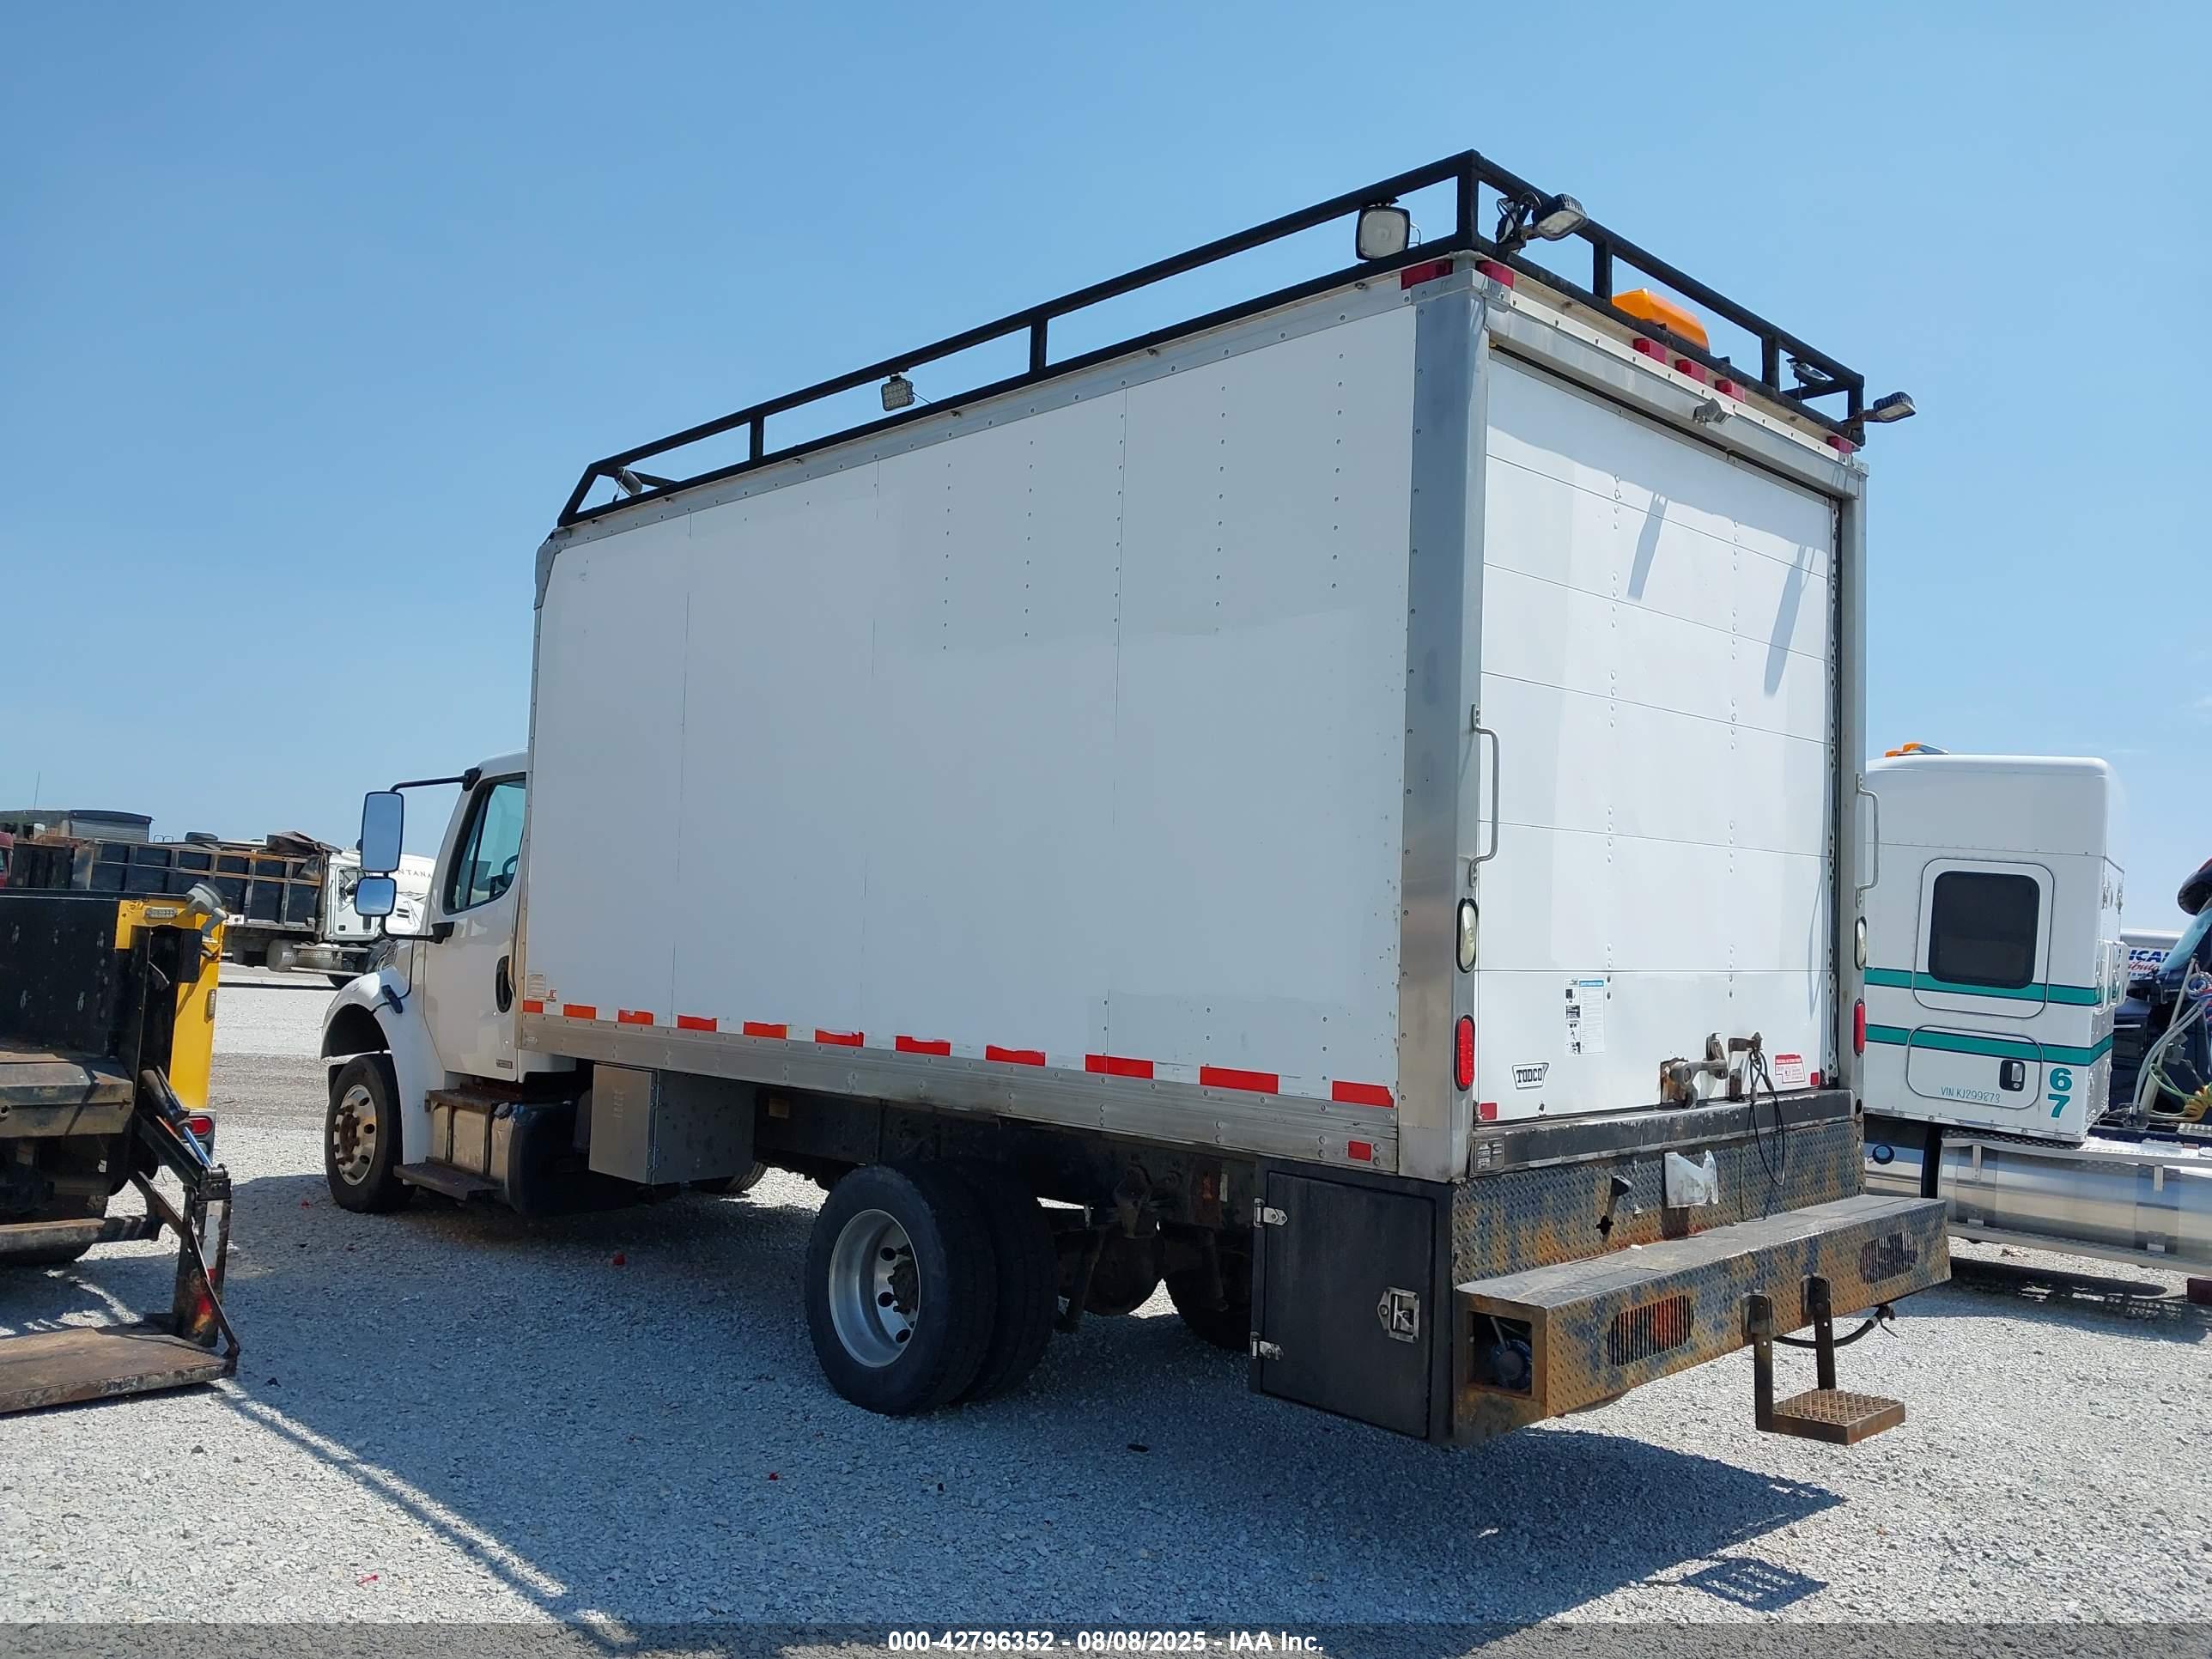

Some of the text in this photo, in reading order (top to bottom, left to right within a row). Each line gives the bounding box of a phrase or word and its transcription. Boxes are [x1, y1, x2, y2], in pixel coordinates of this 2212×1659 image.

[392, 868, 433, 879] NTANA
[1516, 1067, 1543, 1084] TODCO
[1941, 1086, 1954, 1097] VIN
